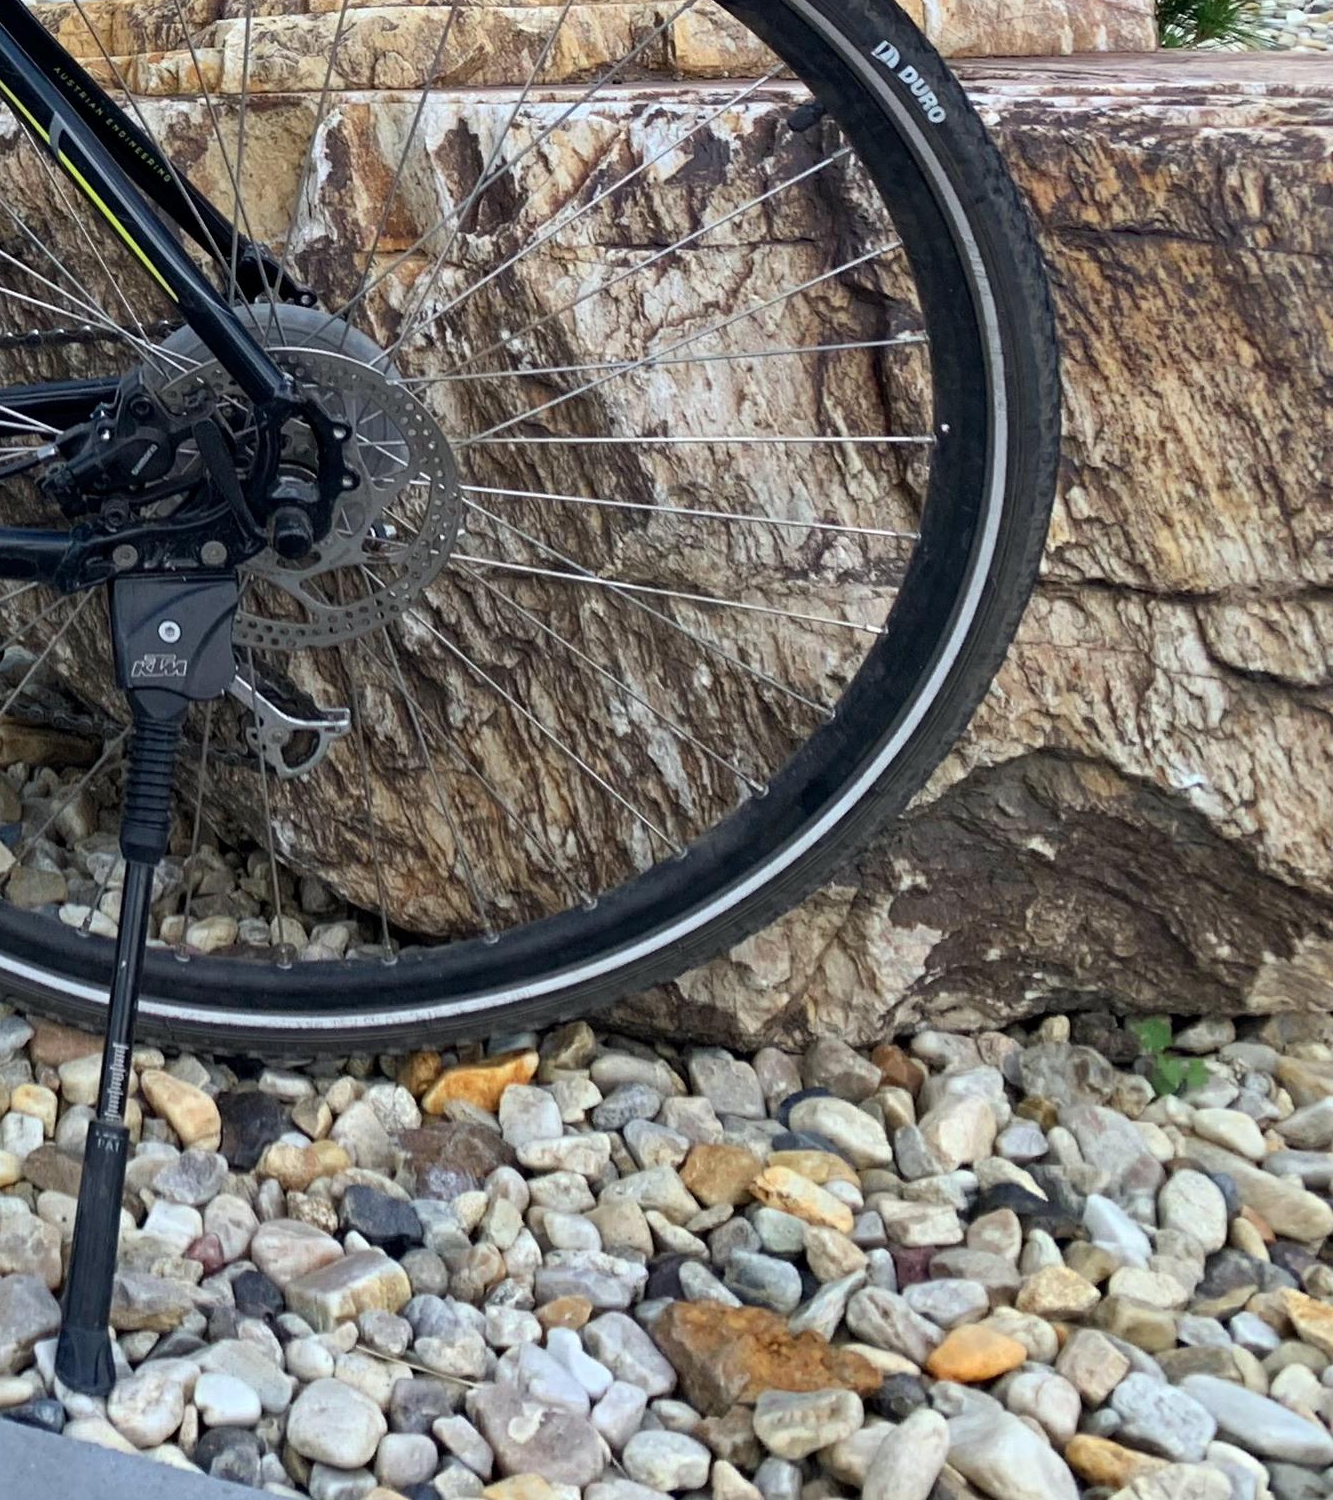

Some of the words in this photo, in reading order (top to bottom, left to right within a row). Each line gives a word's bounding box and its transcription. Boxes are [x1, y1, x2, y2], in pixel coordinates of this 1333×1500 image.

[897, 64, 947, 124] DURO
[53, 67, 104, 116] AUSTRIAN
[105, 118, 172, 183] ENGINEERING
[131, 653, 188, 677] KTM
